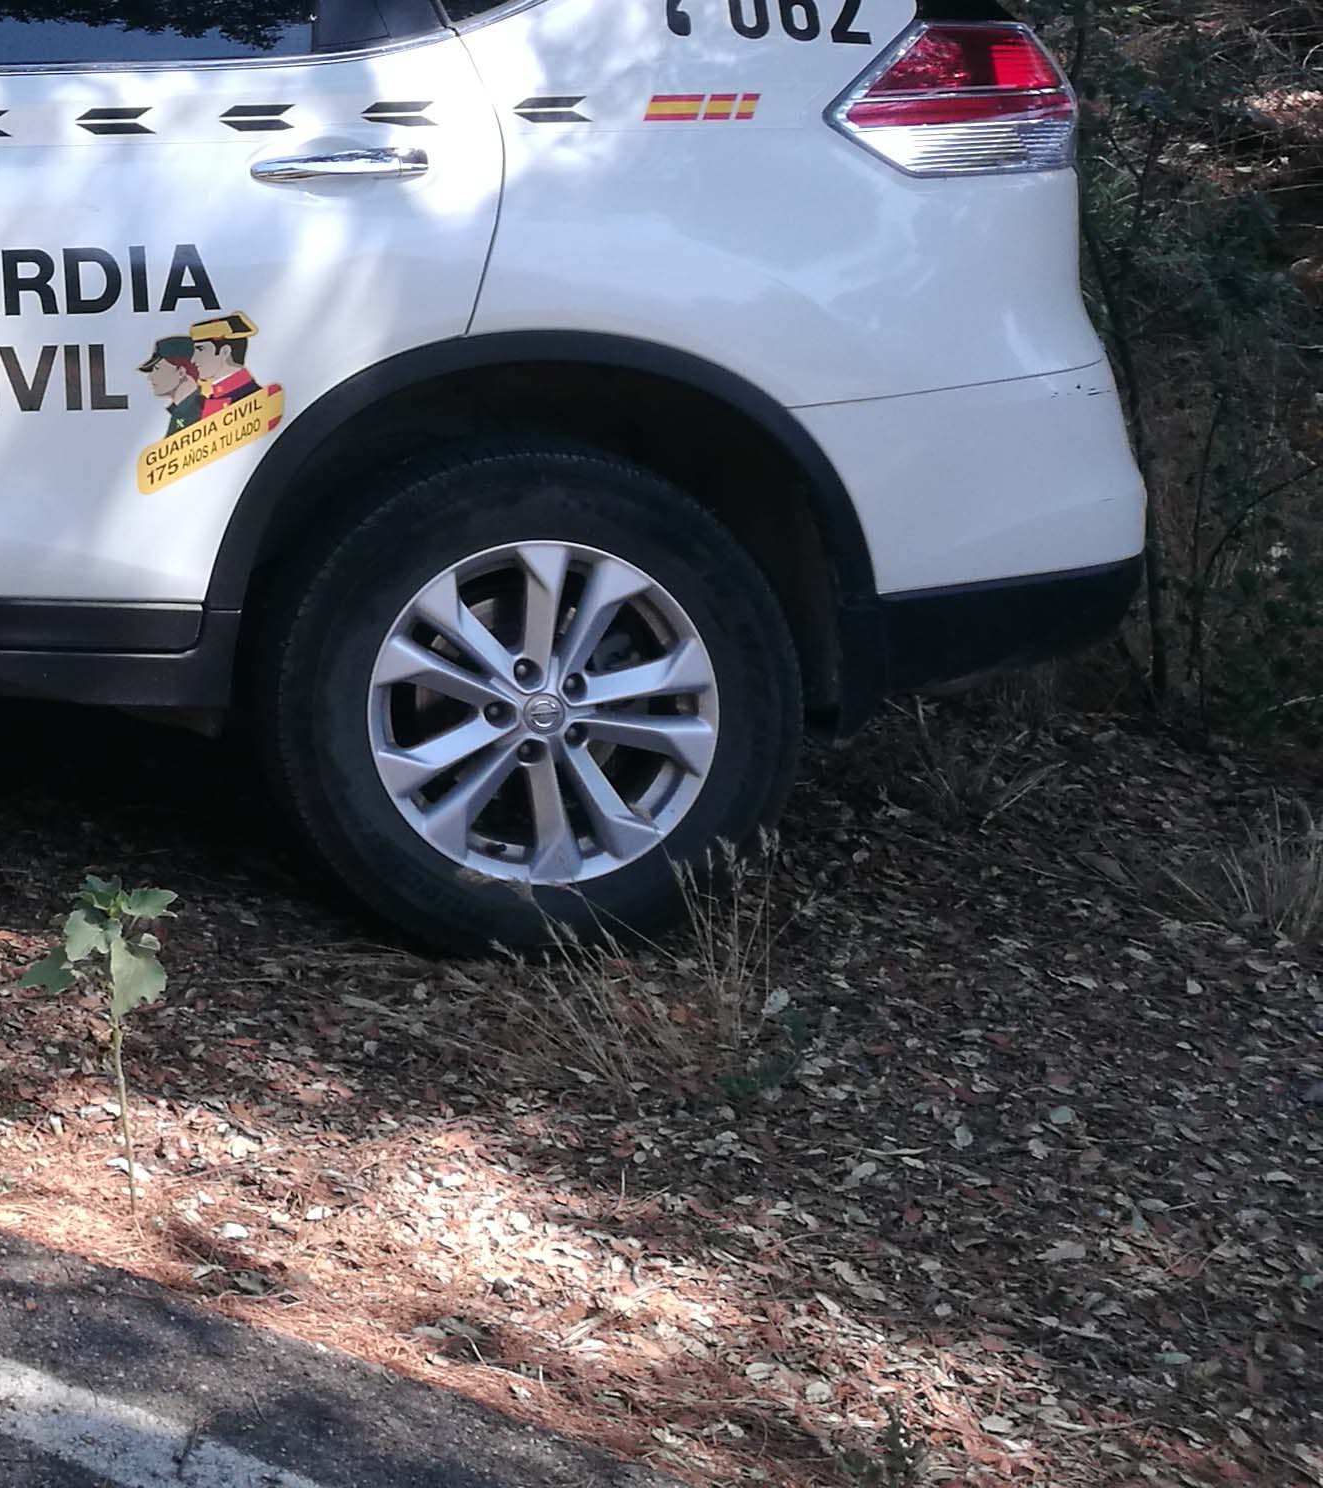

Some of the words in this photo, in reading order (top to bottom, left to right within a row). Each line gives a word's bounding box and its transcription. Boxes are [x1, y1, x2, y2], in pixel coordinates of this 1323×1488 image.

[146, 421, 218, 466] GUARDIA
[222, 399, 263, 426] CIVIL
[146, 458, 179, 485] 175
[183, 445, 209, 469] AÑOS
[210, 441, 218, 455] A
[220, 432, 233, 449] TU
[235, 418, 261, 442] LADO
